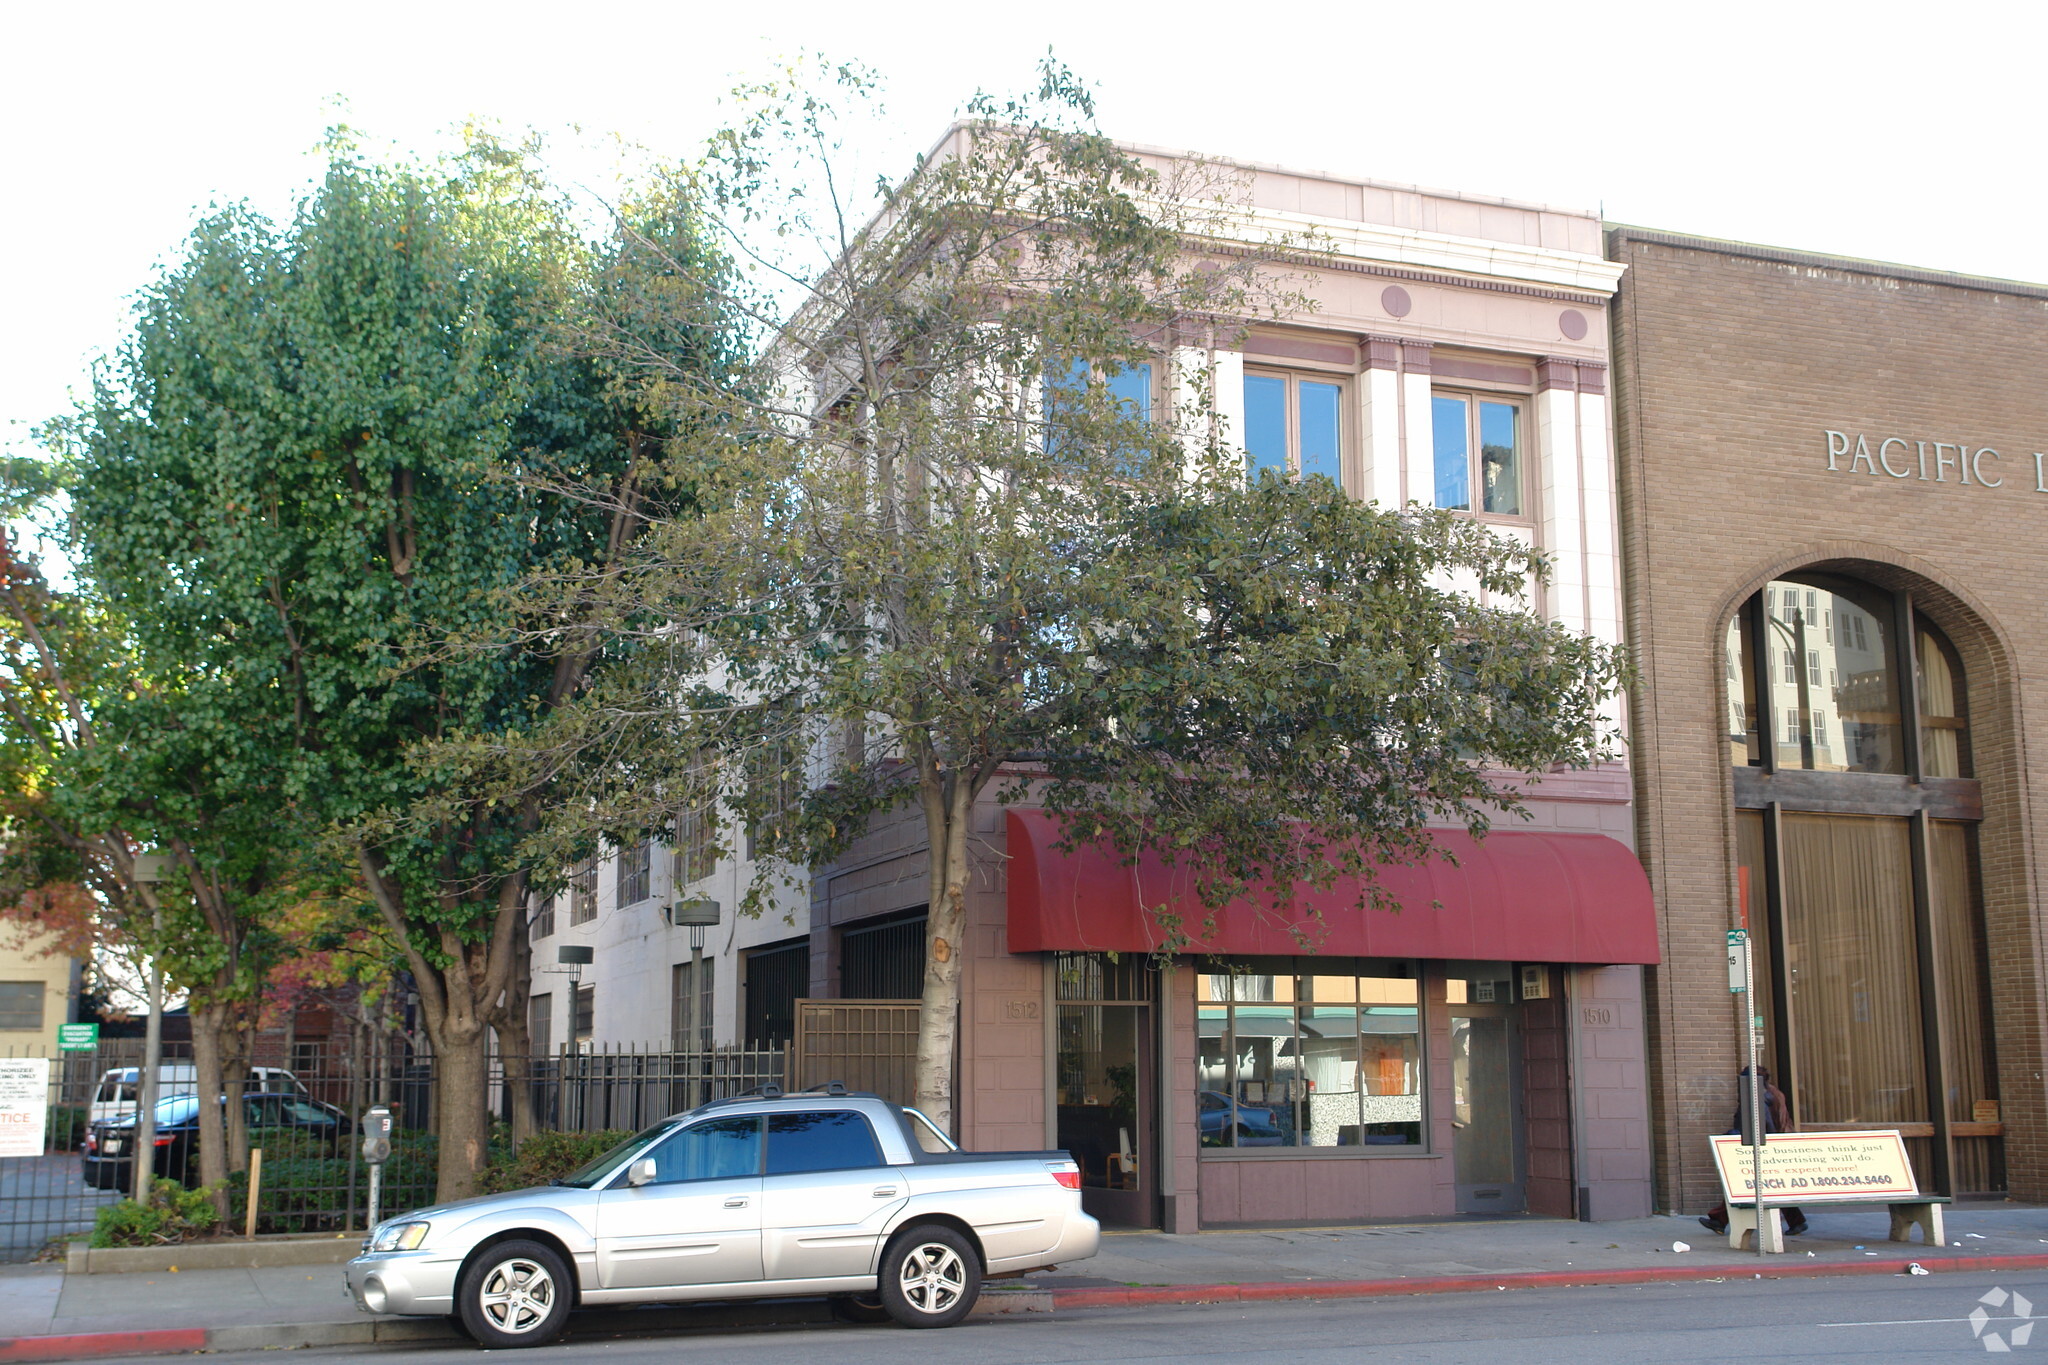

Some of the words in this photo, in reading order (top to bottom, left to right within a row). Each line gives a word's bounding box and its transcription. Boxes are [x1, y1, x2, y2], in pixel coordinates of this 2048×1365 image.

[1824, 429, 2003, 488] PACIFIC
[1006, 1000, 1039, 1019] 1512
[1583, 1008, 1611, 1025] 1510
[1735, 1147, 1768, 1156] Soe
[1773, 1146, 1823, 1155] business
[1827, 1145, 1858, 1153] think
[1862, 1144, 1884, 1153] just
[1762, 1156, 1827, 1165] advertising
[1832, 1154, 1853, 1162] will
[1857, 1154, 1875, 1162] do.
[1784, 1167, 1823, 1175] expect
[1827, 1164, 1859, 1173] more!
[1745, 1177, 1786, 1190] BNCH
[1791, 1177, 1809, 1188] AD
[1810, 1174, 1893, 1187] 1.800.234.5460
